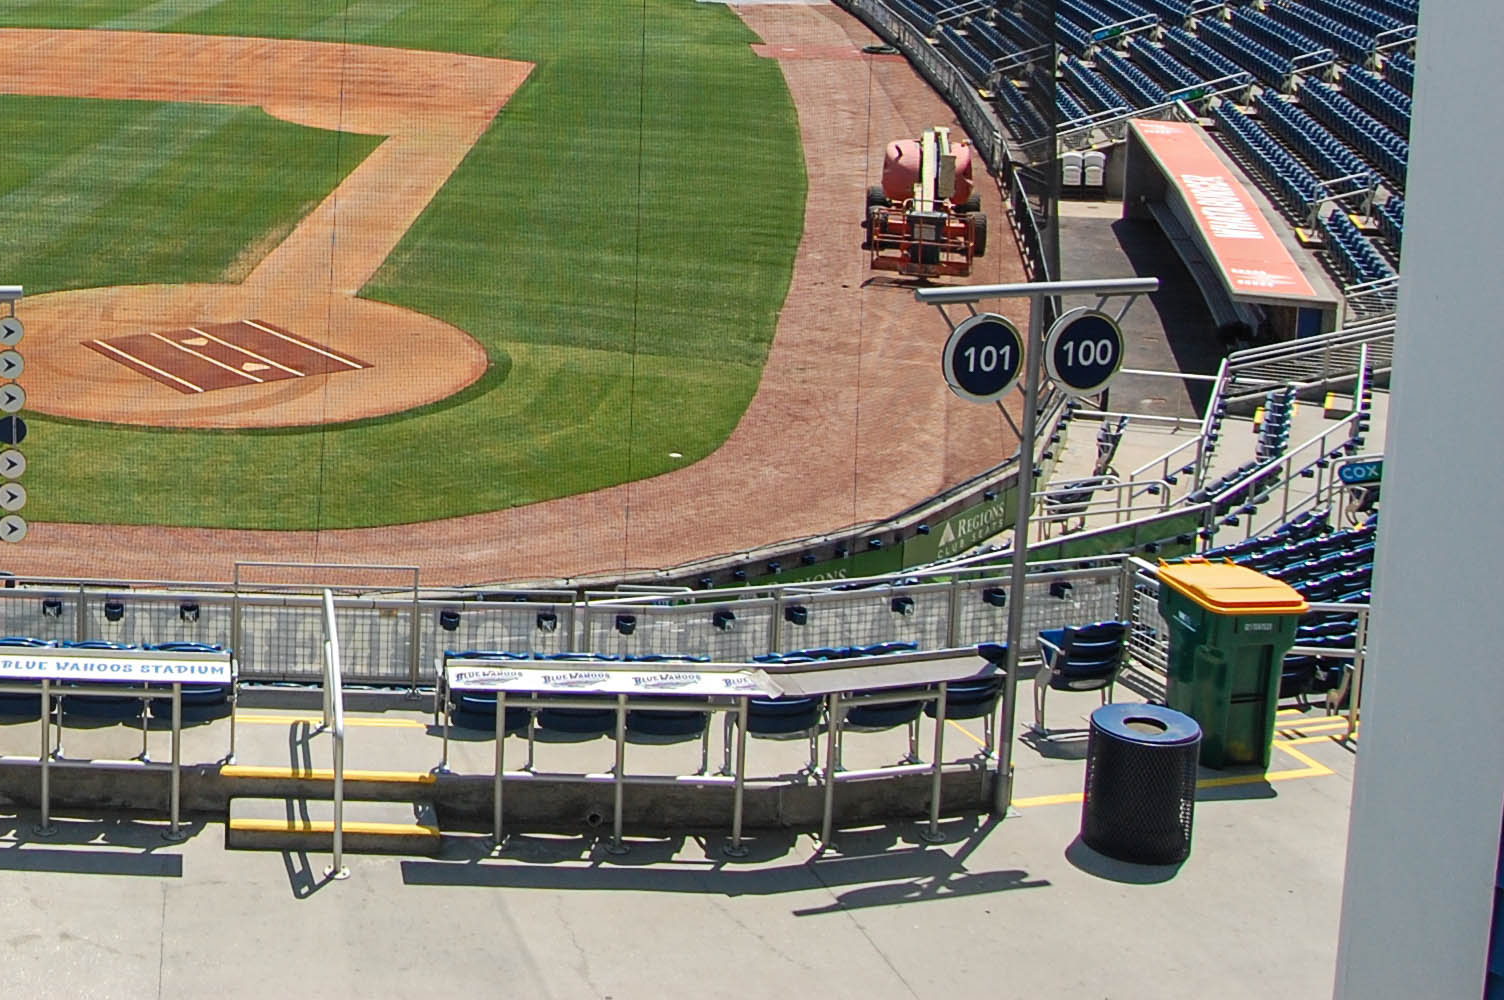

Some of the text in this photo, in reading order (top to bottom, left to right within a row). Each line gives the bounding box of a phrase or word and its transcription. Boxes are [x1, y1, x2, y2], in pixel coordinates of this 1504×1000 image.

[964, 344, 1011, 373] 101
[1062, 339, 1113, 367] 100
[1342, 465, 1379, 480] COX
[958, 504, 1005, 538] REGIONS
[937, 518, 1004, 559] CLUB SEATS
[1, 658, 48, 671] BLUE
[55, 661, 134, 674] WAHOOS
[140, 663, 226, 676] STADIUM
[455, 670, 481, 682] BLUE
[541, 674, 568, 684] BLUE
[632, 674, 659, 687] BLUE
